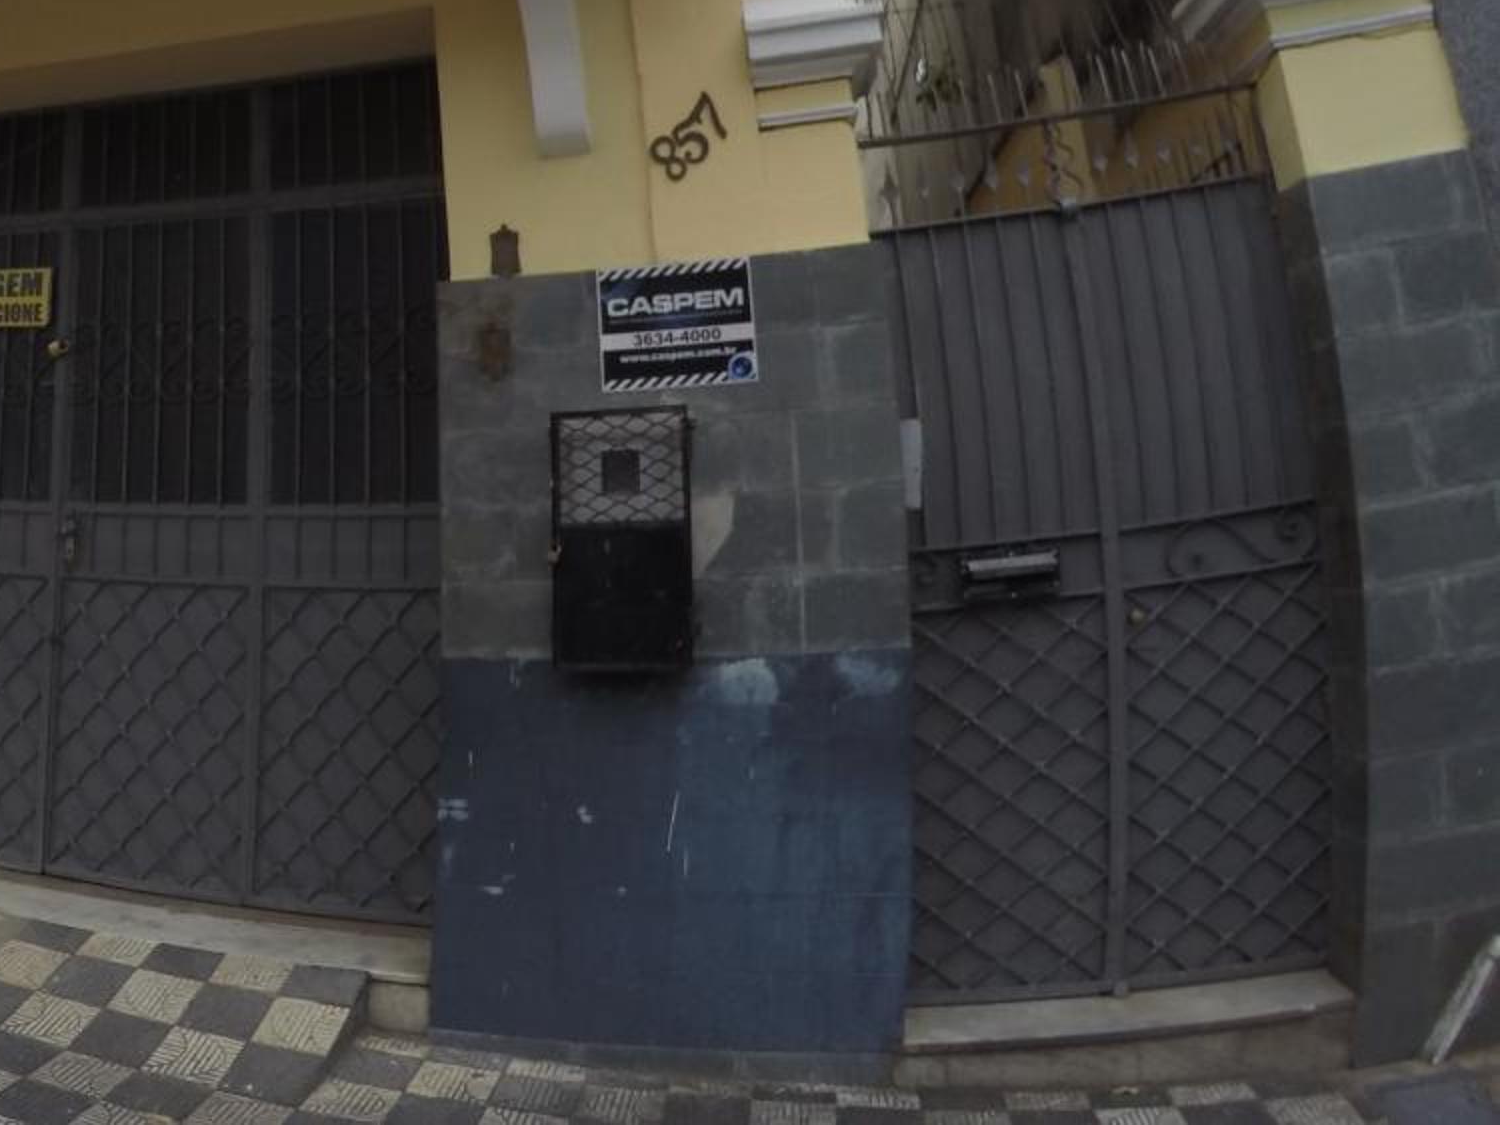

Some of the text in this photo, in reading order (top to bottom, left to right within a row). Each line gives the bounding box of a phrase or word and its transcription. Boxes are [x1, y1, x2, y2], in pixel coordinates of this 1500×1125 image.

[649, 91, 727, 183] 857
[607, 287, 744, 316] CASPEM
[633, 328, 722, 347] 3634-4000
